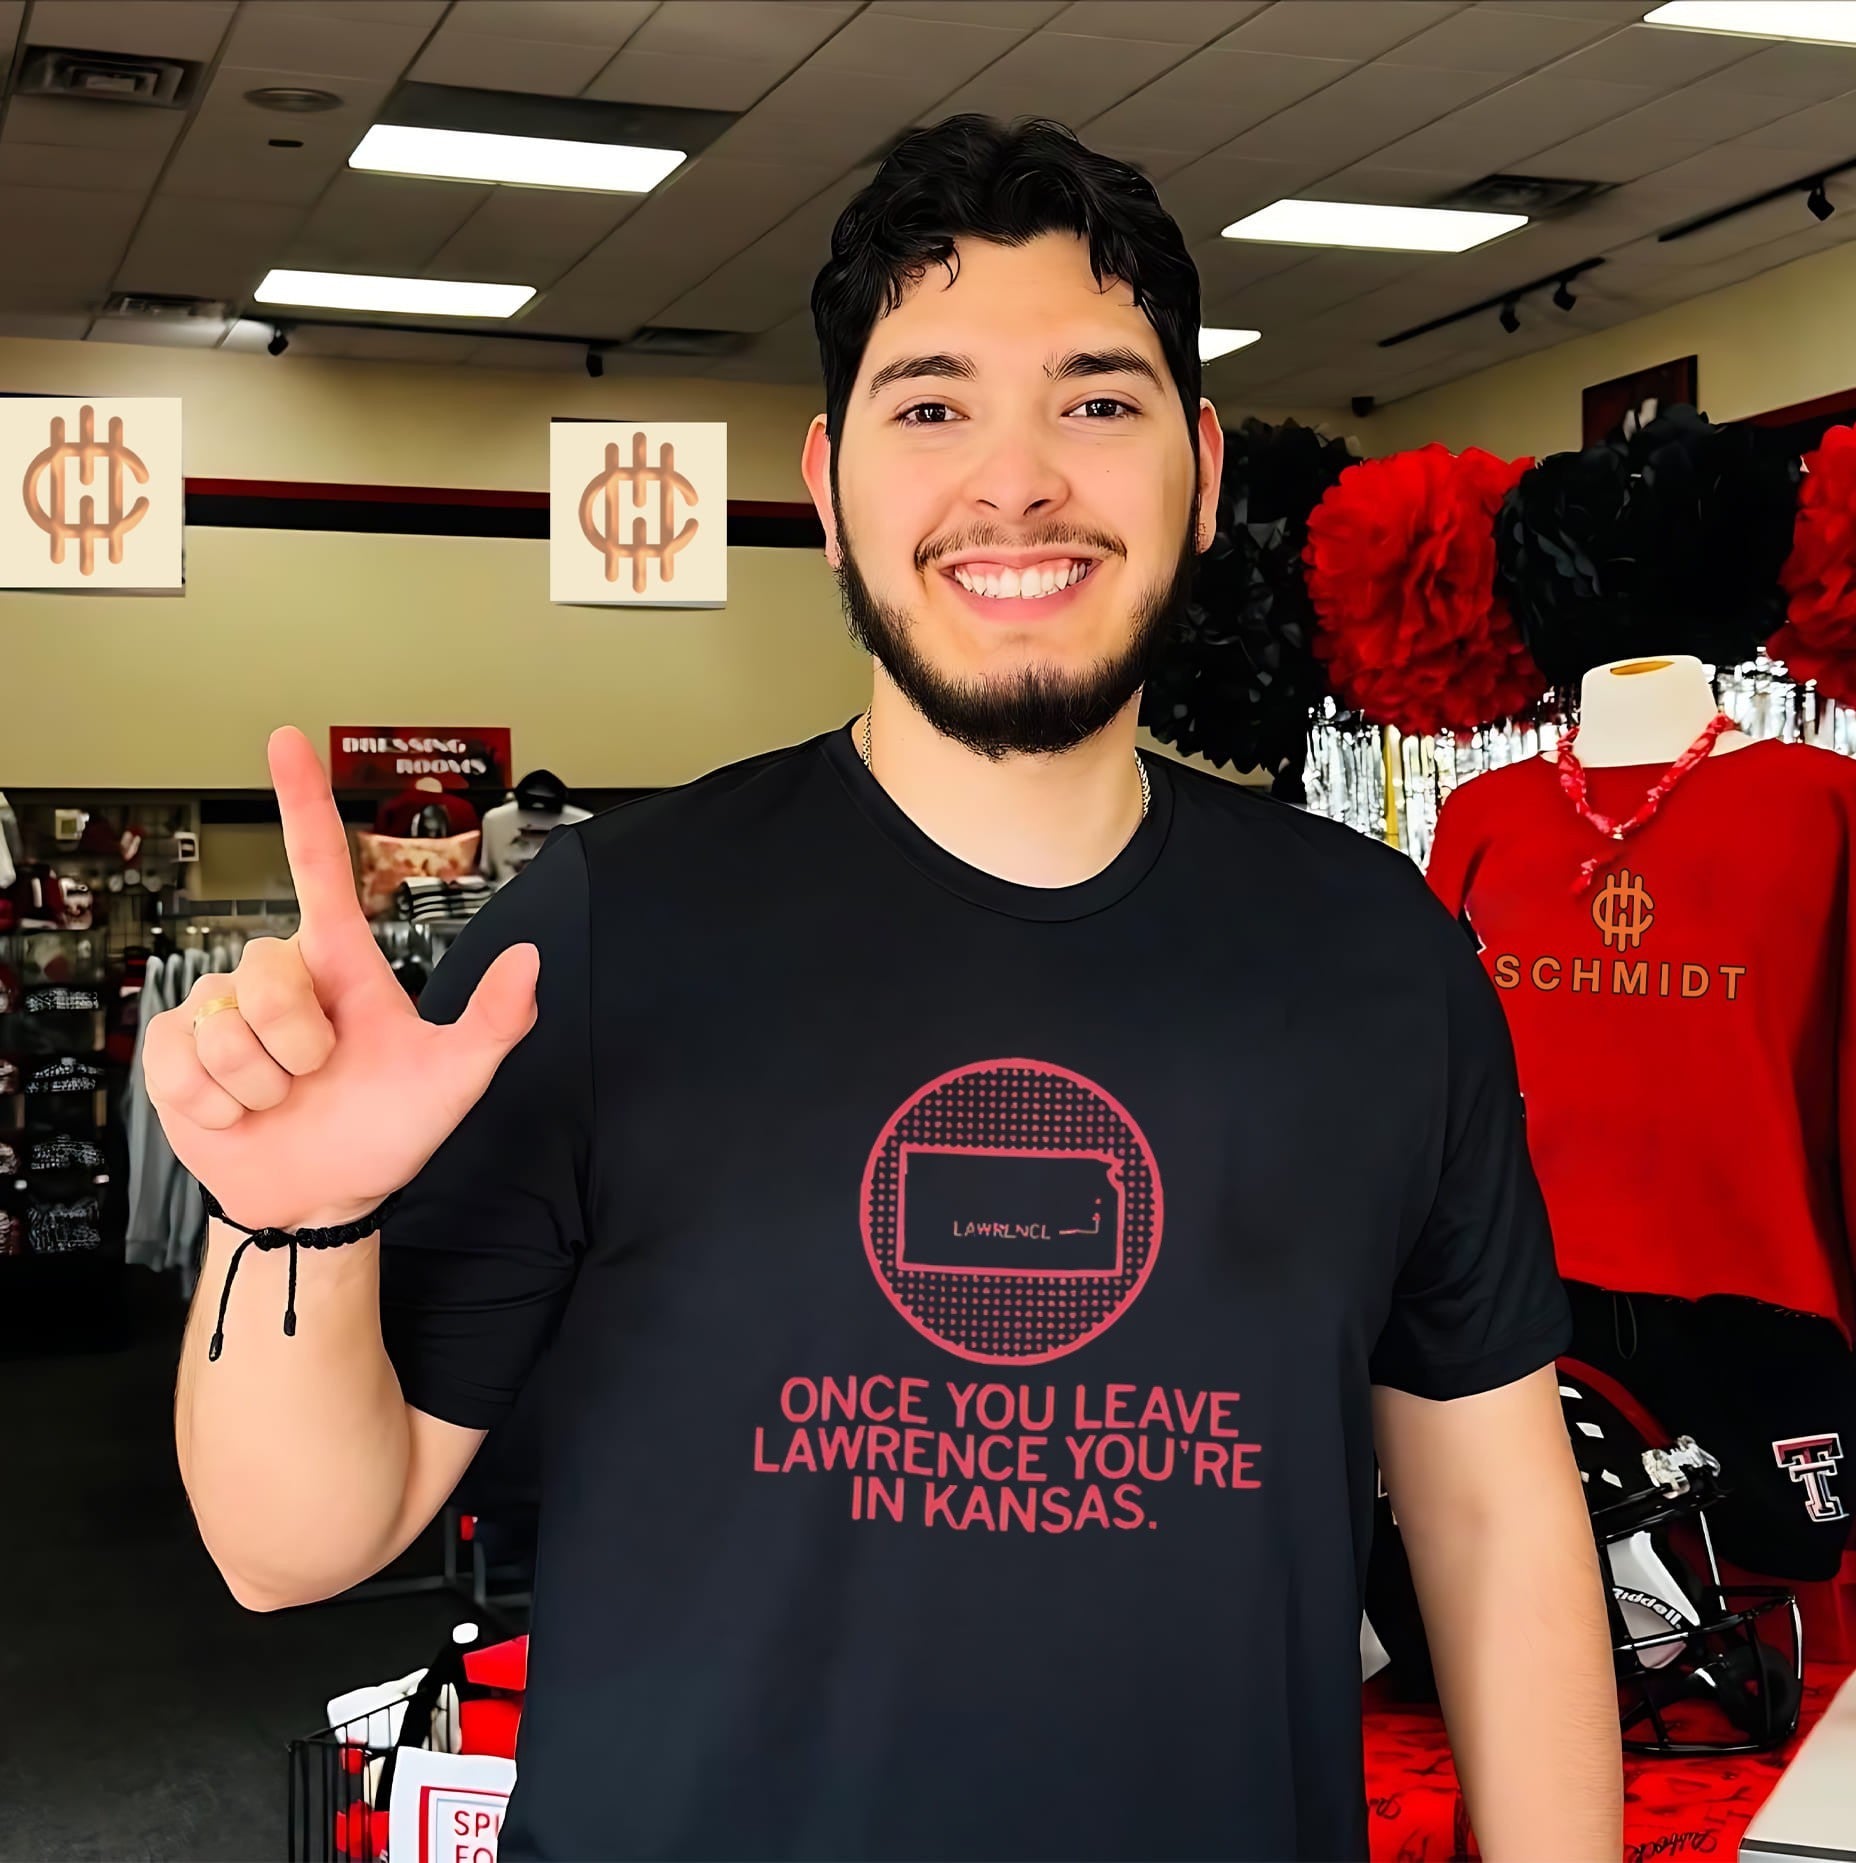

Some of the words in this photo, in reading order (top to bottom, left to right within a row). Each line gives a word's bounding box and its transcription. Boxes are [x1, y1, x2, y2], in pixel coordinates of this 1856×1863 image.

[342, 737, 467, 754] DRESSING
[396, 758, 487, 775] ROOMS
[1494, 954, 1747, 1000] SCHMIDT
[780, 1374, 930, 1425] ONCE
[946, 1382, 1056, 1431] YOU
[1074, 1383, 1241, 1438] LEAVE
[754, 1425, 1048, 1482] LAWRENCE
[1065, 1433, 1263, 1490] YOU'RE
[851, 1475, 905, 1522] IN
[924, 1482, 1158, 1534] KANSAS.
